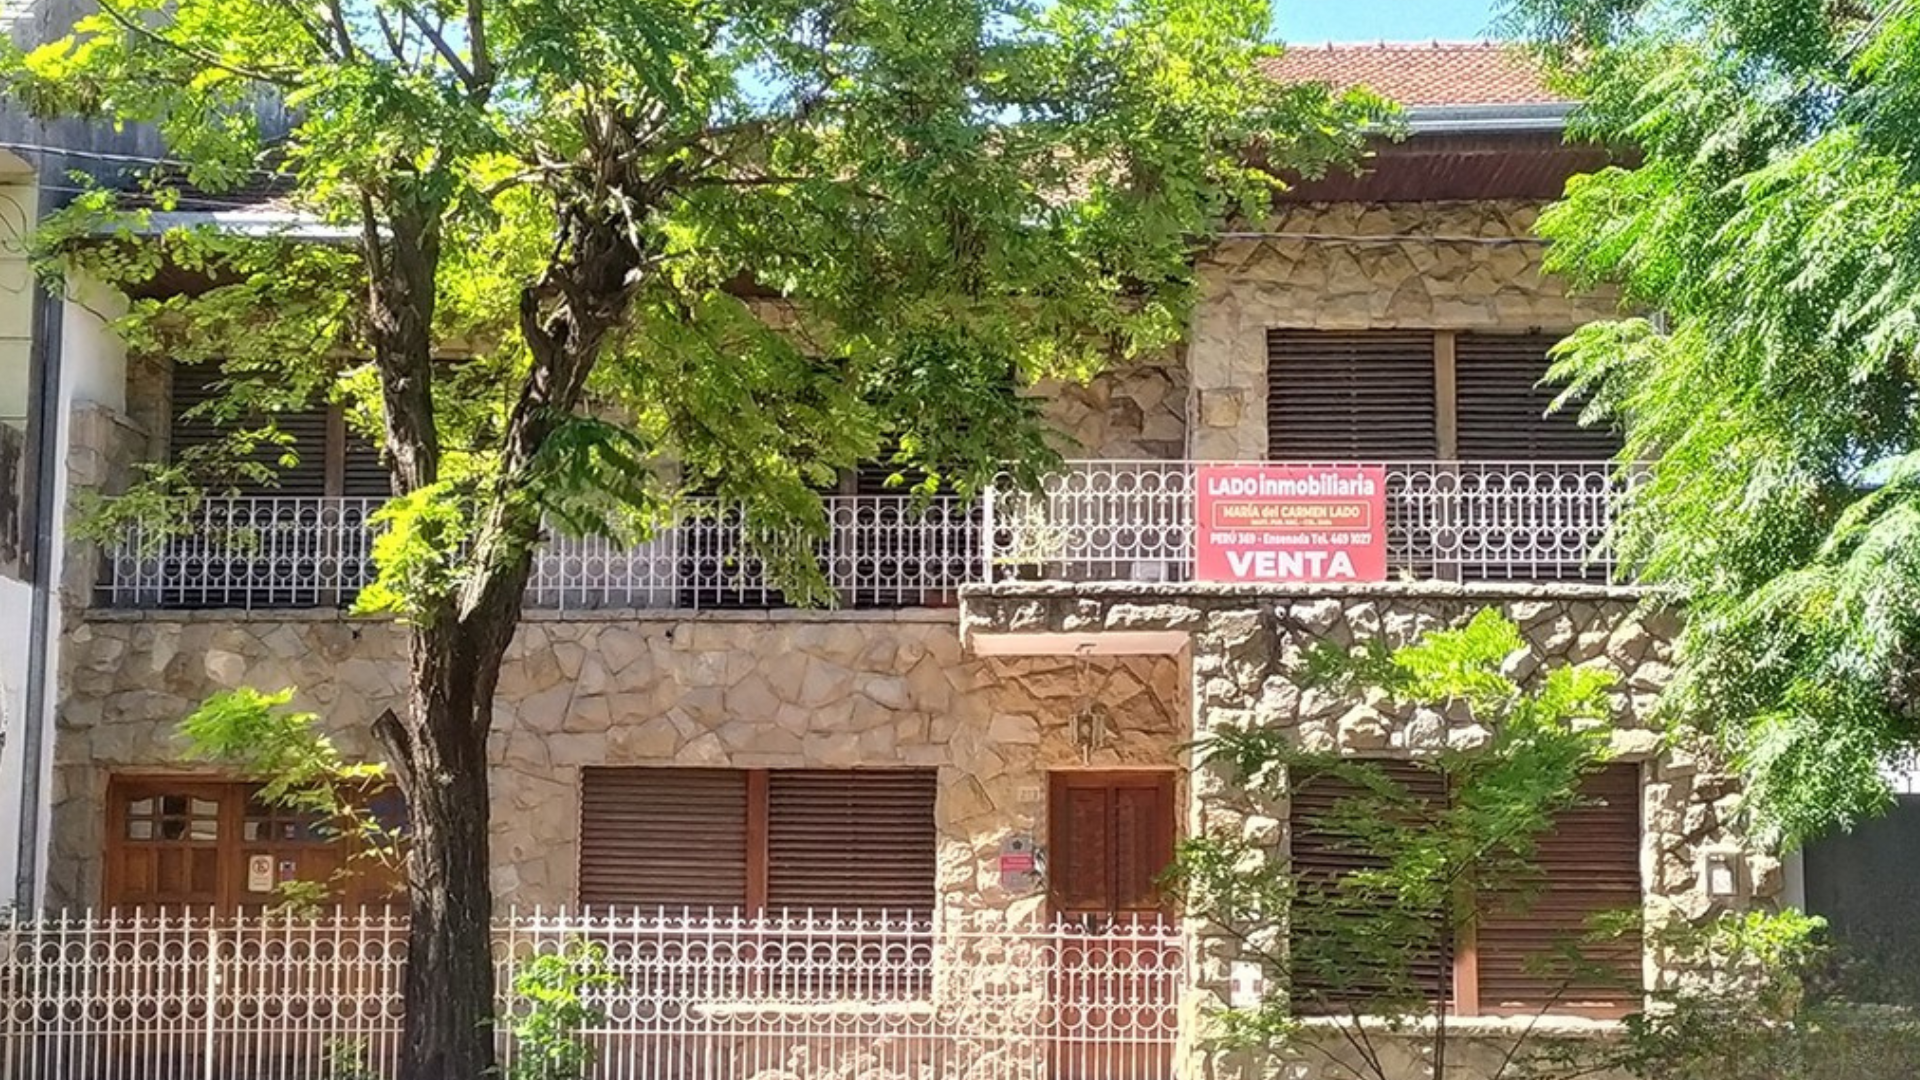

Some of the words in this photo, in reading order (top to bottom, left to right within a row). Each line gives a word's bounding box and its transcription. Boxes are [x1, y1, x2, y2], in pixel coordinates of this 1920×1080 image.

[1223, 503, 1260, 517] MARÍA
[1262, 505, 1279, 517] del
[1281, 505, 1327, 517] CARMEN
[1328, 505, 1361, 517] LADO
[1210, 531, 1237, 545] PERÚ
[1263, 532, 1310, 545] Ensenada
[1226, 550, 1356, 578] VENTA
